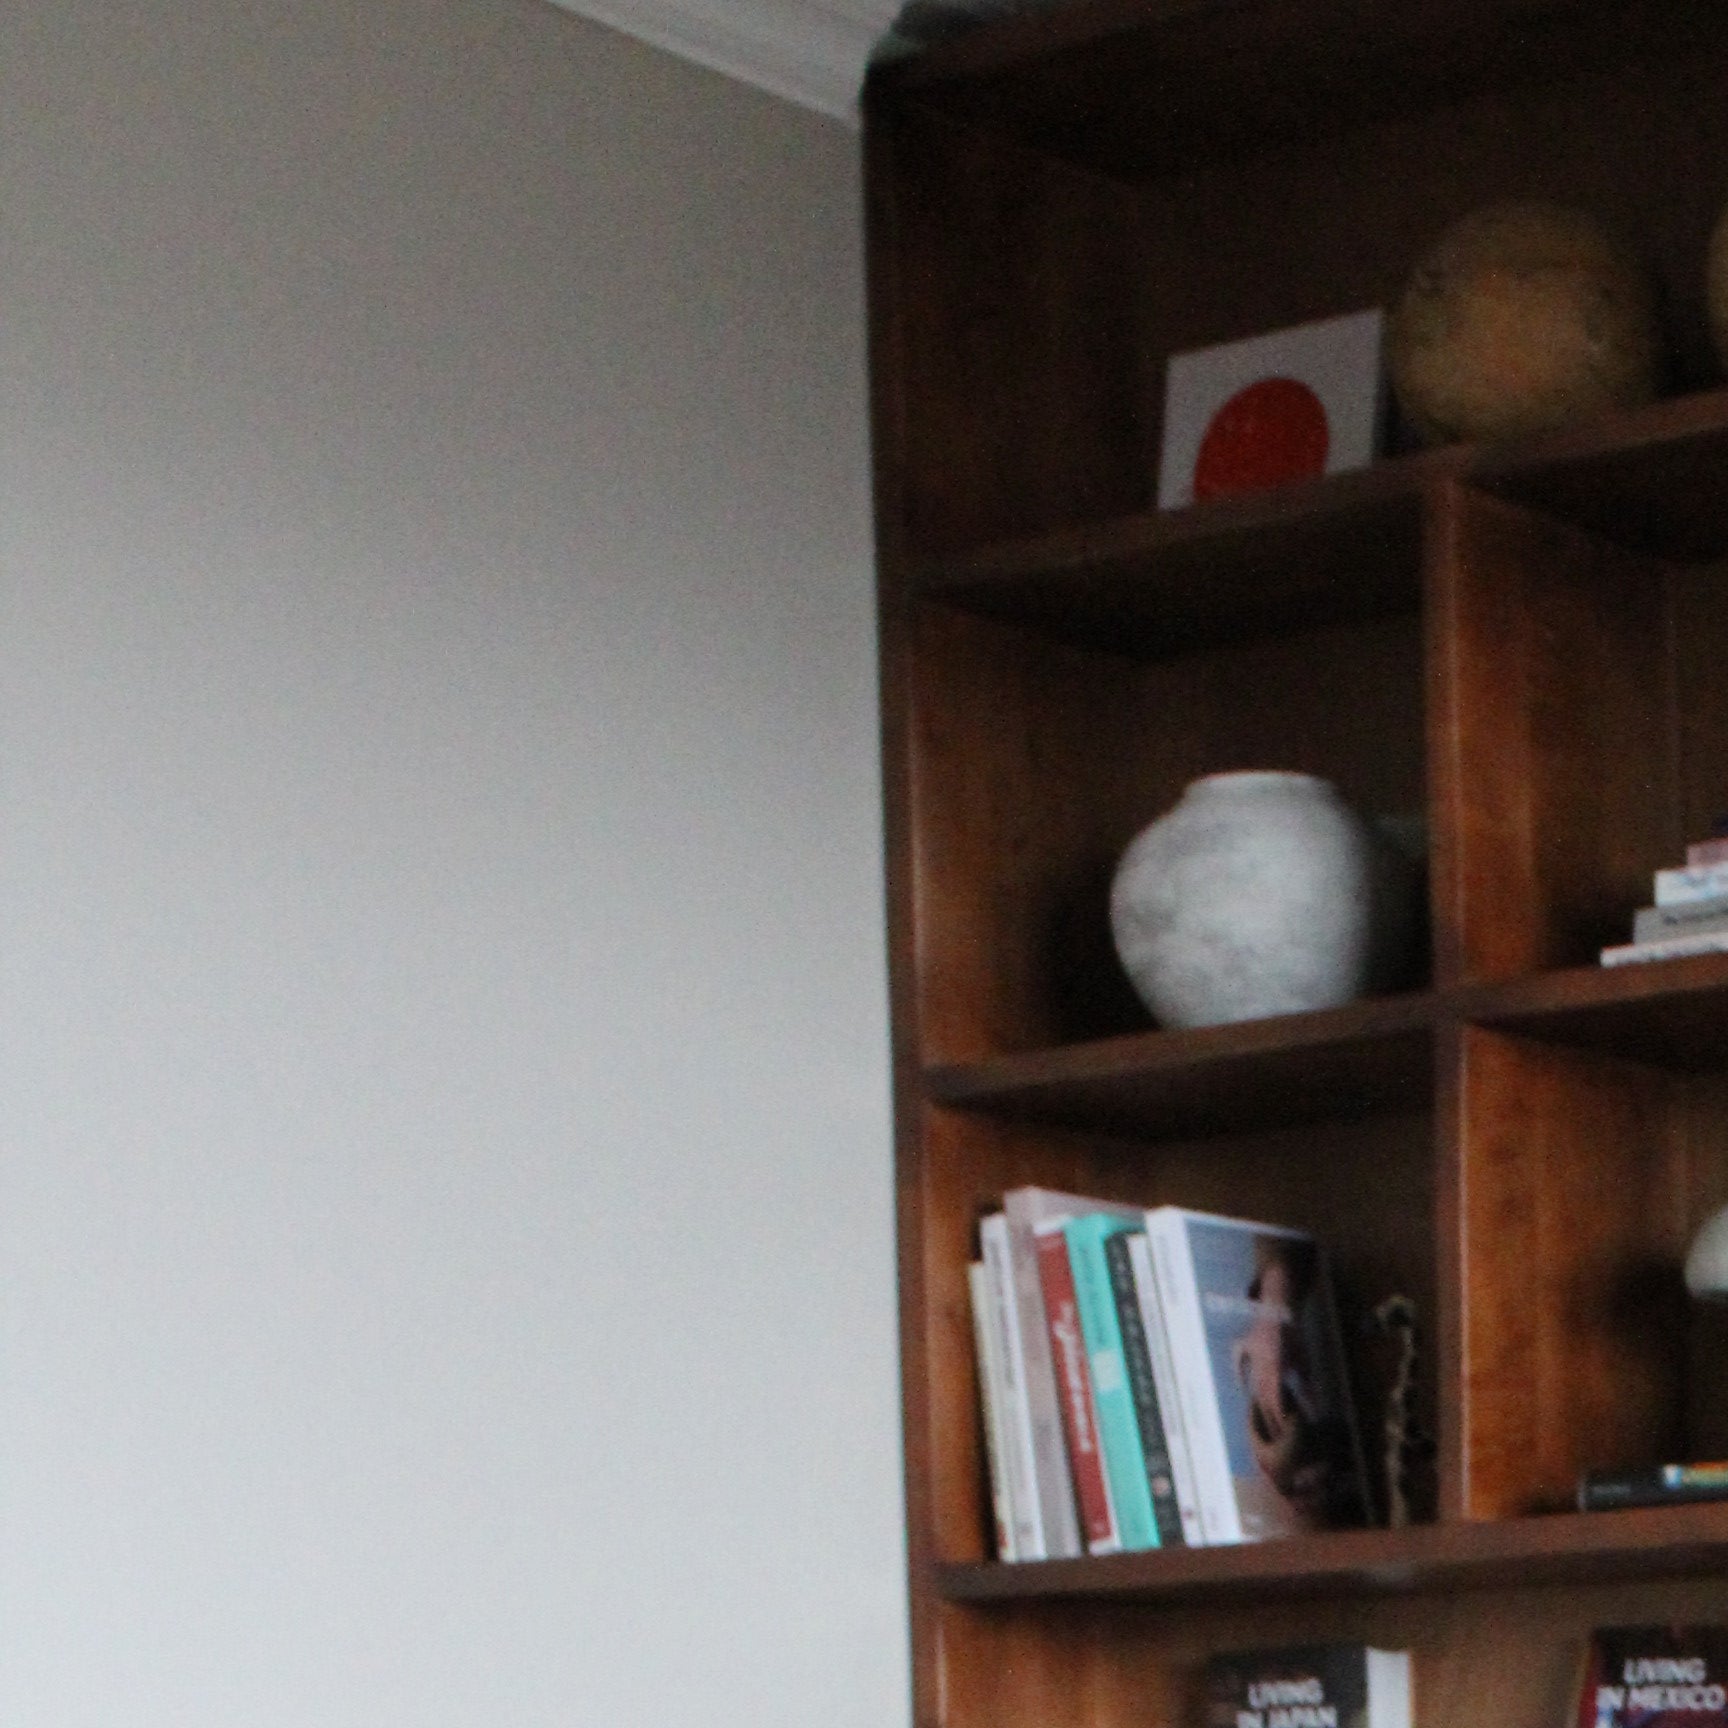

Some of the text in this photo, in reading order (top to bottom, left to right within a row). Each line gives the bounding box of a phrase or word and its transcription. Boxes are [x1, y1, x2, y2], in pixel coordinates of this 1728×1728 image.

[1623, 1657, 1706, 1684] LIVING
[1247, 1677, 1324, 1709] LIVING
[1597, 1684, 1727, 1712] IN MEXICO
